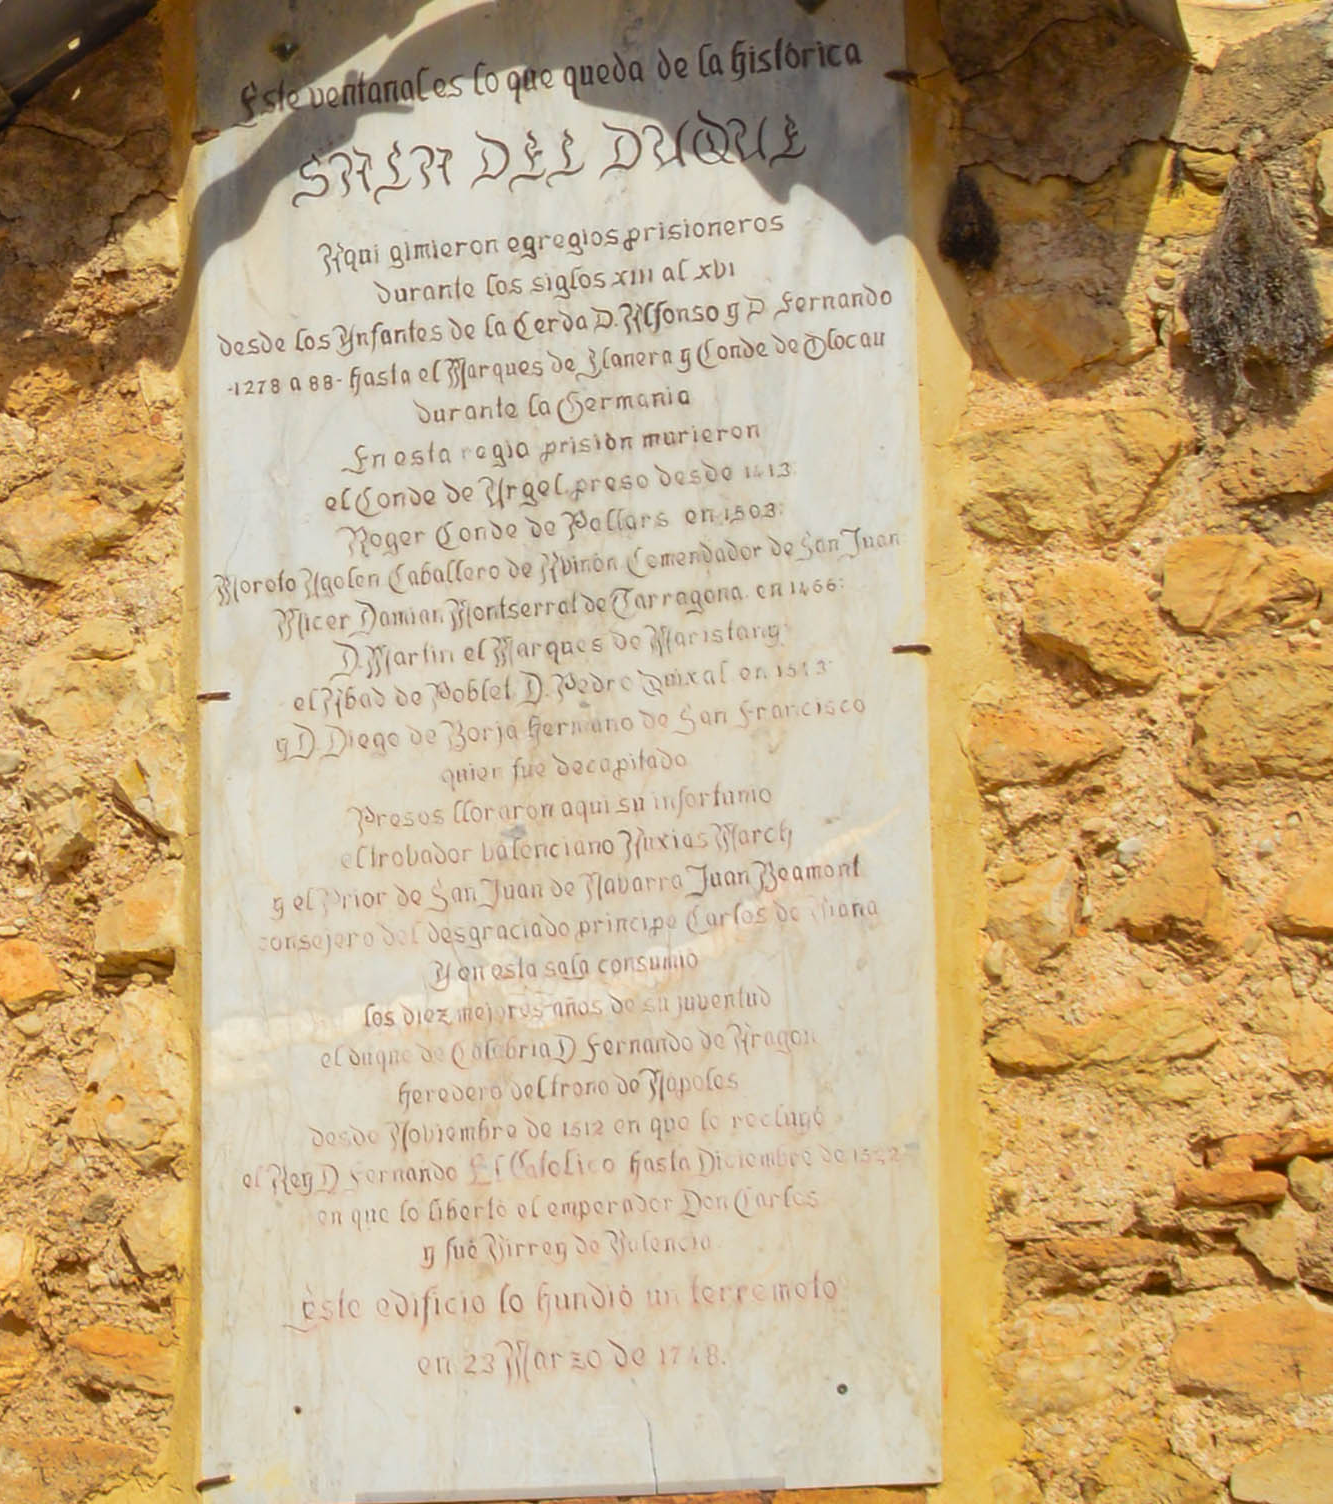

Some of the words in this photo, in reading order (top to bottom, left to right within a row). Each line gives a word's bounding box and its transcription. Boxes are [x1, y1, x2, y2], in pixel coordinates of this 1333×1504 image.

[233, 80, 298, 128] Este
[310, 66, 430, 109] ventanal
[437, 74, 463, 97] es
[474, 62, 498, 96] lo
[507, 67, 552, 104] que
[563, 52, 644, 101] queda
[658, 48, 685, 80] de
[698, 43, 723, 77] la
[470, 128, 584, 192] DEL
[600, 109, 807, 179] DUQUE
[390, 237, 499, 269] gimieron
[507, 227, 619, 259] egregios
[623, 214, 784, 252] prisioneros
[373, 276, 475, 304] durante
[487, 273, 523, 297] los
[532, 265, 606, 300] siglos
[663, 258, 689, 283] al
[217, 331, 286, 357] desde
[296, 328, 331, 352] los
[449, 317, 475, 340] de
[486, 313, 507, 337] la
[513, 309, 588, 340] Cerda
[418, 359, 441, 384] el
[547, 351, 575, 374] de
[697, 335, 769, 369] Conde
[771, 334, 798, 355] de
[413, 396, 518, 424] durante
[529, 393, 551, 418] la
[394, 442, 452, 466] esta
[642, 422, 760, 449] murieron
[325, 487, 351, 512] el
[355, 486, 435, 517] Conde
[442, 480, 473, 505] de
[570, 472, 648, 502] preso
[654, 459, 733, 488] desde
[436, 520, 517, 550] Conde
[525, 515, 556, 539] de
[685, 506, 715, 524] en
[504, 557, 532, 579] de
[768, 535, 793, 557] de
[583, 594, 606, 613] de
[757, 582, 782, 599] en
[464, 638, 486, 662] el
[608, 631, 641, 651] de
[294, 687, 320, 711] el
[395, 682, 422, 706] de
[405, 725, 436, 745] de
[638, 710, 669, 729] de
[395, 883, 422, 906] de
[550, 876, 574, 898] de
[776, 899, 799, 922] de
[458, 963, 485, 982] en
[364, 1002, 394, 1027] los
[610, 993, 634, 1015] de
[700, 1026, 725, 1050] de
[613, 1074, 640, 1095] de
[523, 1116, 551, 1139] de
